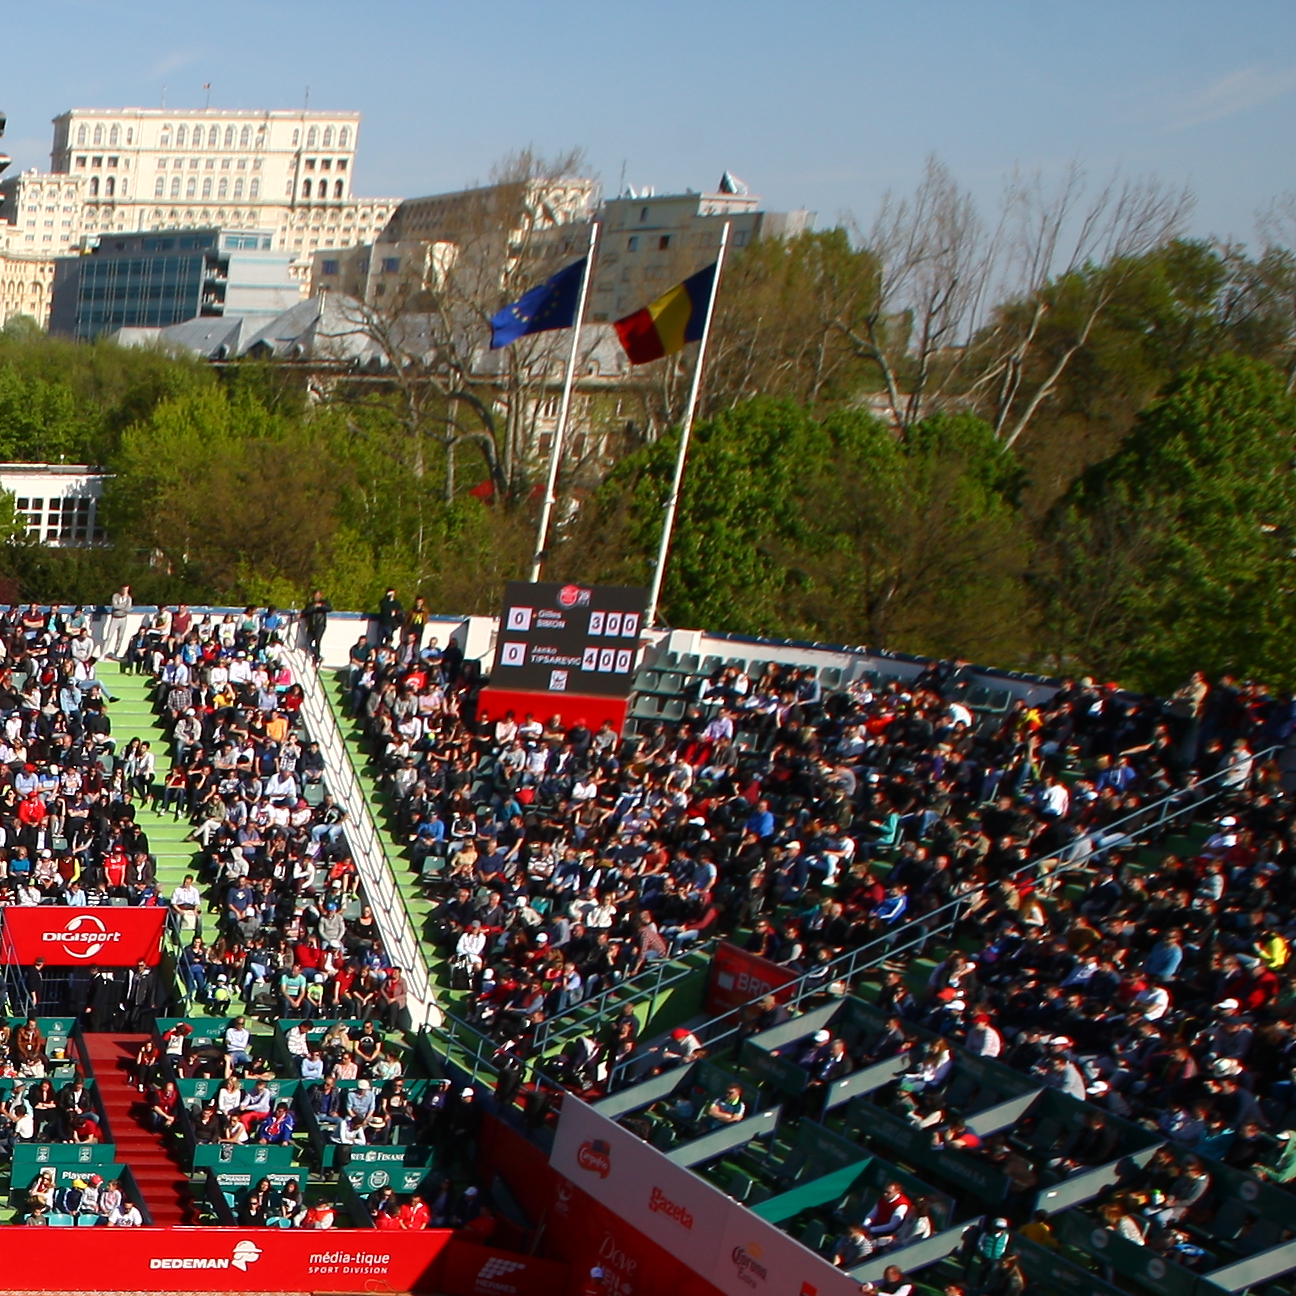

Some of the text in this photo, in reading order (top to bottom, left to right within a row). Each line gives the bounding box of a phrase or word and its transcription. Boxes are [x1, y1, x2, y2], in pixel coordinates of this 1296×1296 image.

[515, 612, 524, 625] 0
[592, 616, 635, 631] 3 0 0
[509, 648, 518, 660] 0
[585, 652, 627, 667] 4 0 0
[649, 1187, 694, 1230] gazeta
[309, 1251, 390, 1266] média-tique
[598, 1230, 638, 1277] Dove
[149, 1258, 230, 1269] DEDEMAN
[308, 1266, 388, 1274] SPORT DIVISION
